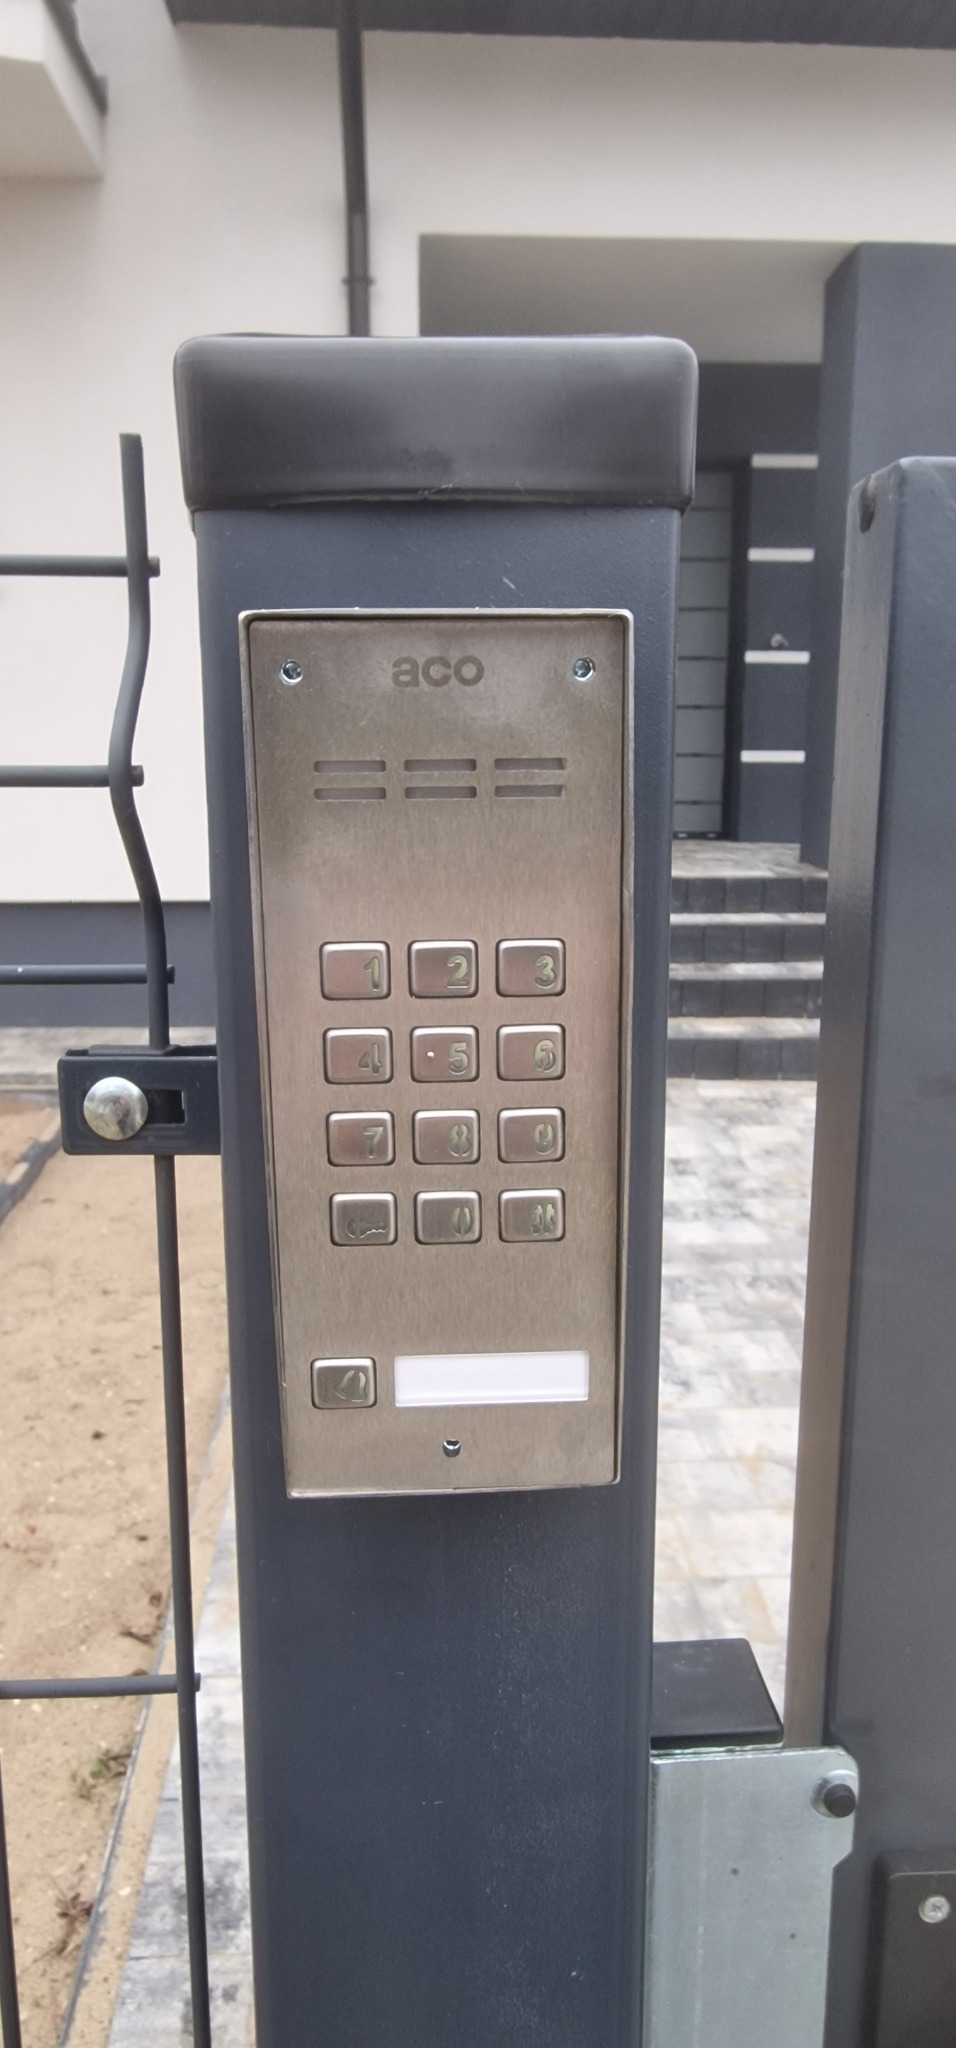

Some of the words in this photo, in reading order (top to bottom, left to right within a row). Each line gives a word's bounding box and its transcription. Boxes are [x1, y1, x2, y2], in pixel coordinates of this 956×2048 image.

[391, 655, 485, 688] aco
[363, 956, 380, 991] 1
[447, 954, 469, 989] 2
[534, 954, 556, 988] 3
[358, 1042, 382, 1076] 4
[448, 1042, 468, 1075] 5
[533, 1039, 556, 1072] 6
[364, 1126, 384, 1158] 7
[449, 1124, 471, 1157] 8
[533, 1123, 556, 1155] 9
[452, 1207, 473, 1237] 0
